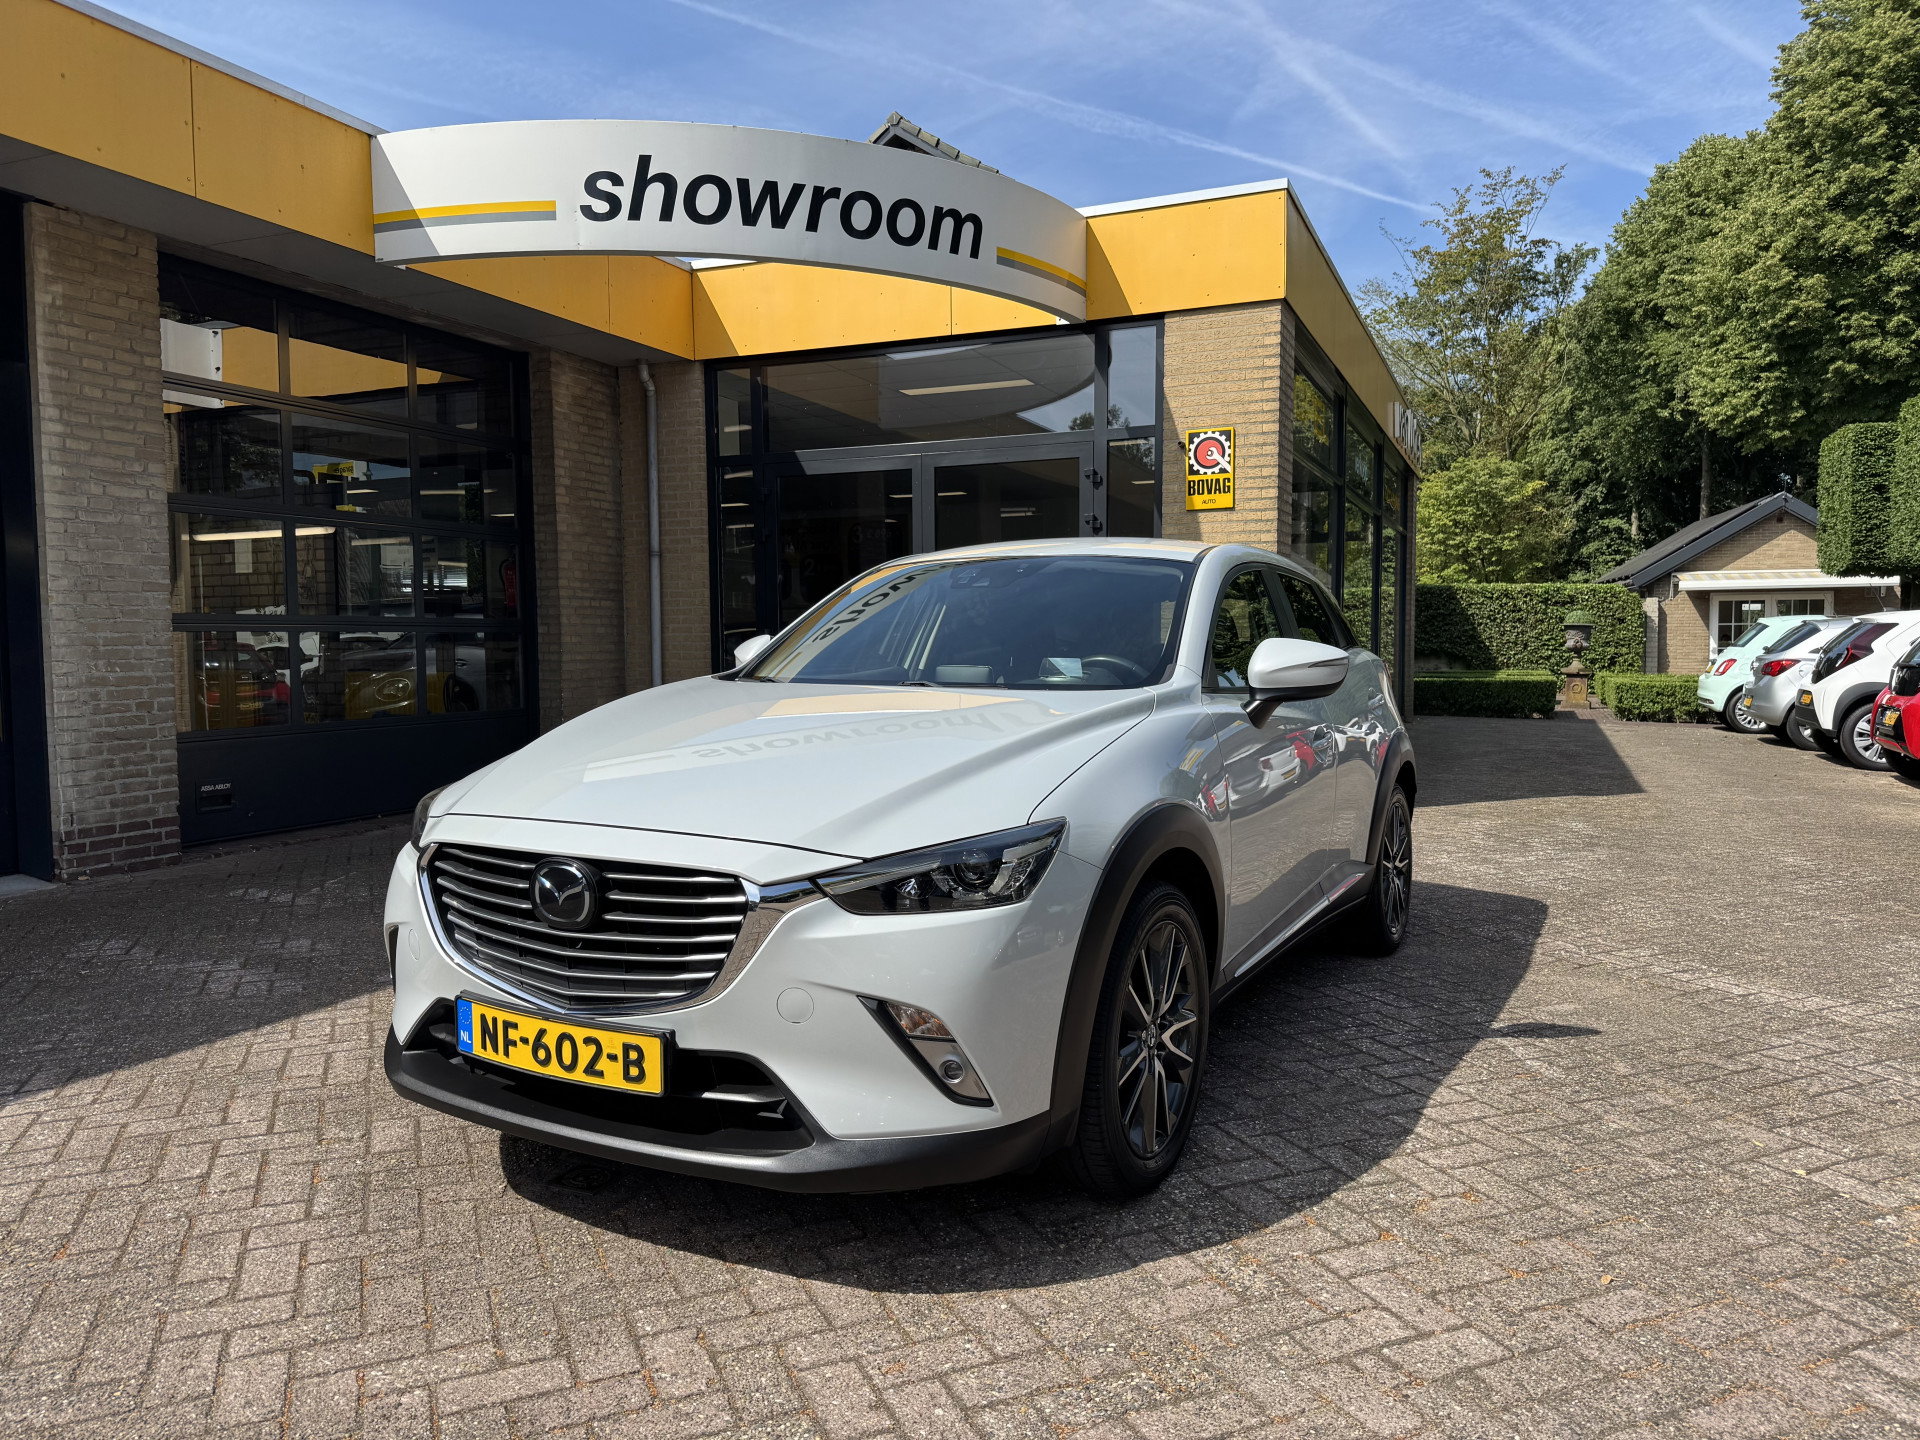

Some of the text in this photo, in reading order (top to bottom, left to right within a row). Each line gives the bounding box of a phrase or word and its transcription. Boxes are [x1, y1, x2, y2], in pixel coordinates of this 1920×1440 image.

[579, 154, 984, 260] showroom
[1187, 477, 1231, 496] BOVAG
[200, 782, 232, 792] ASSA ABLOY
[460, 1029, 472, 1044] NL
[480, 1013, 646, 1083] NF-602-B
